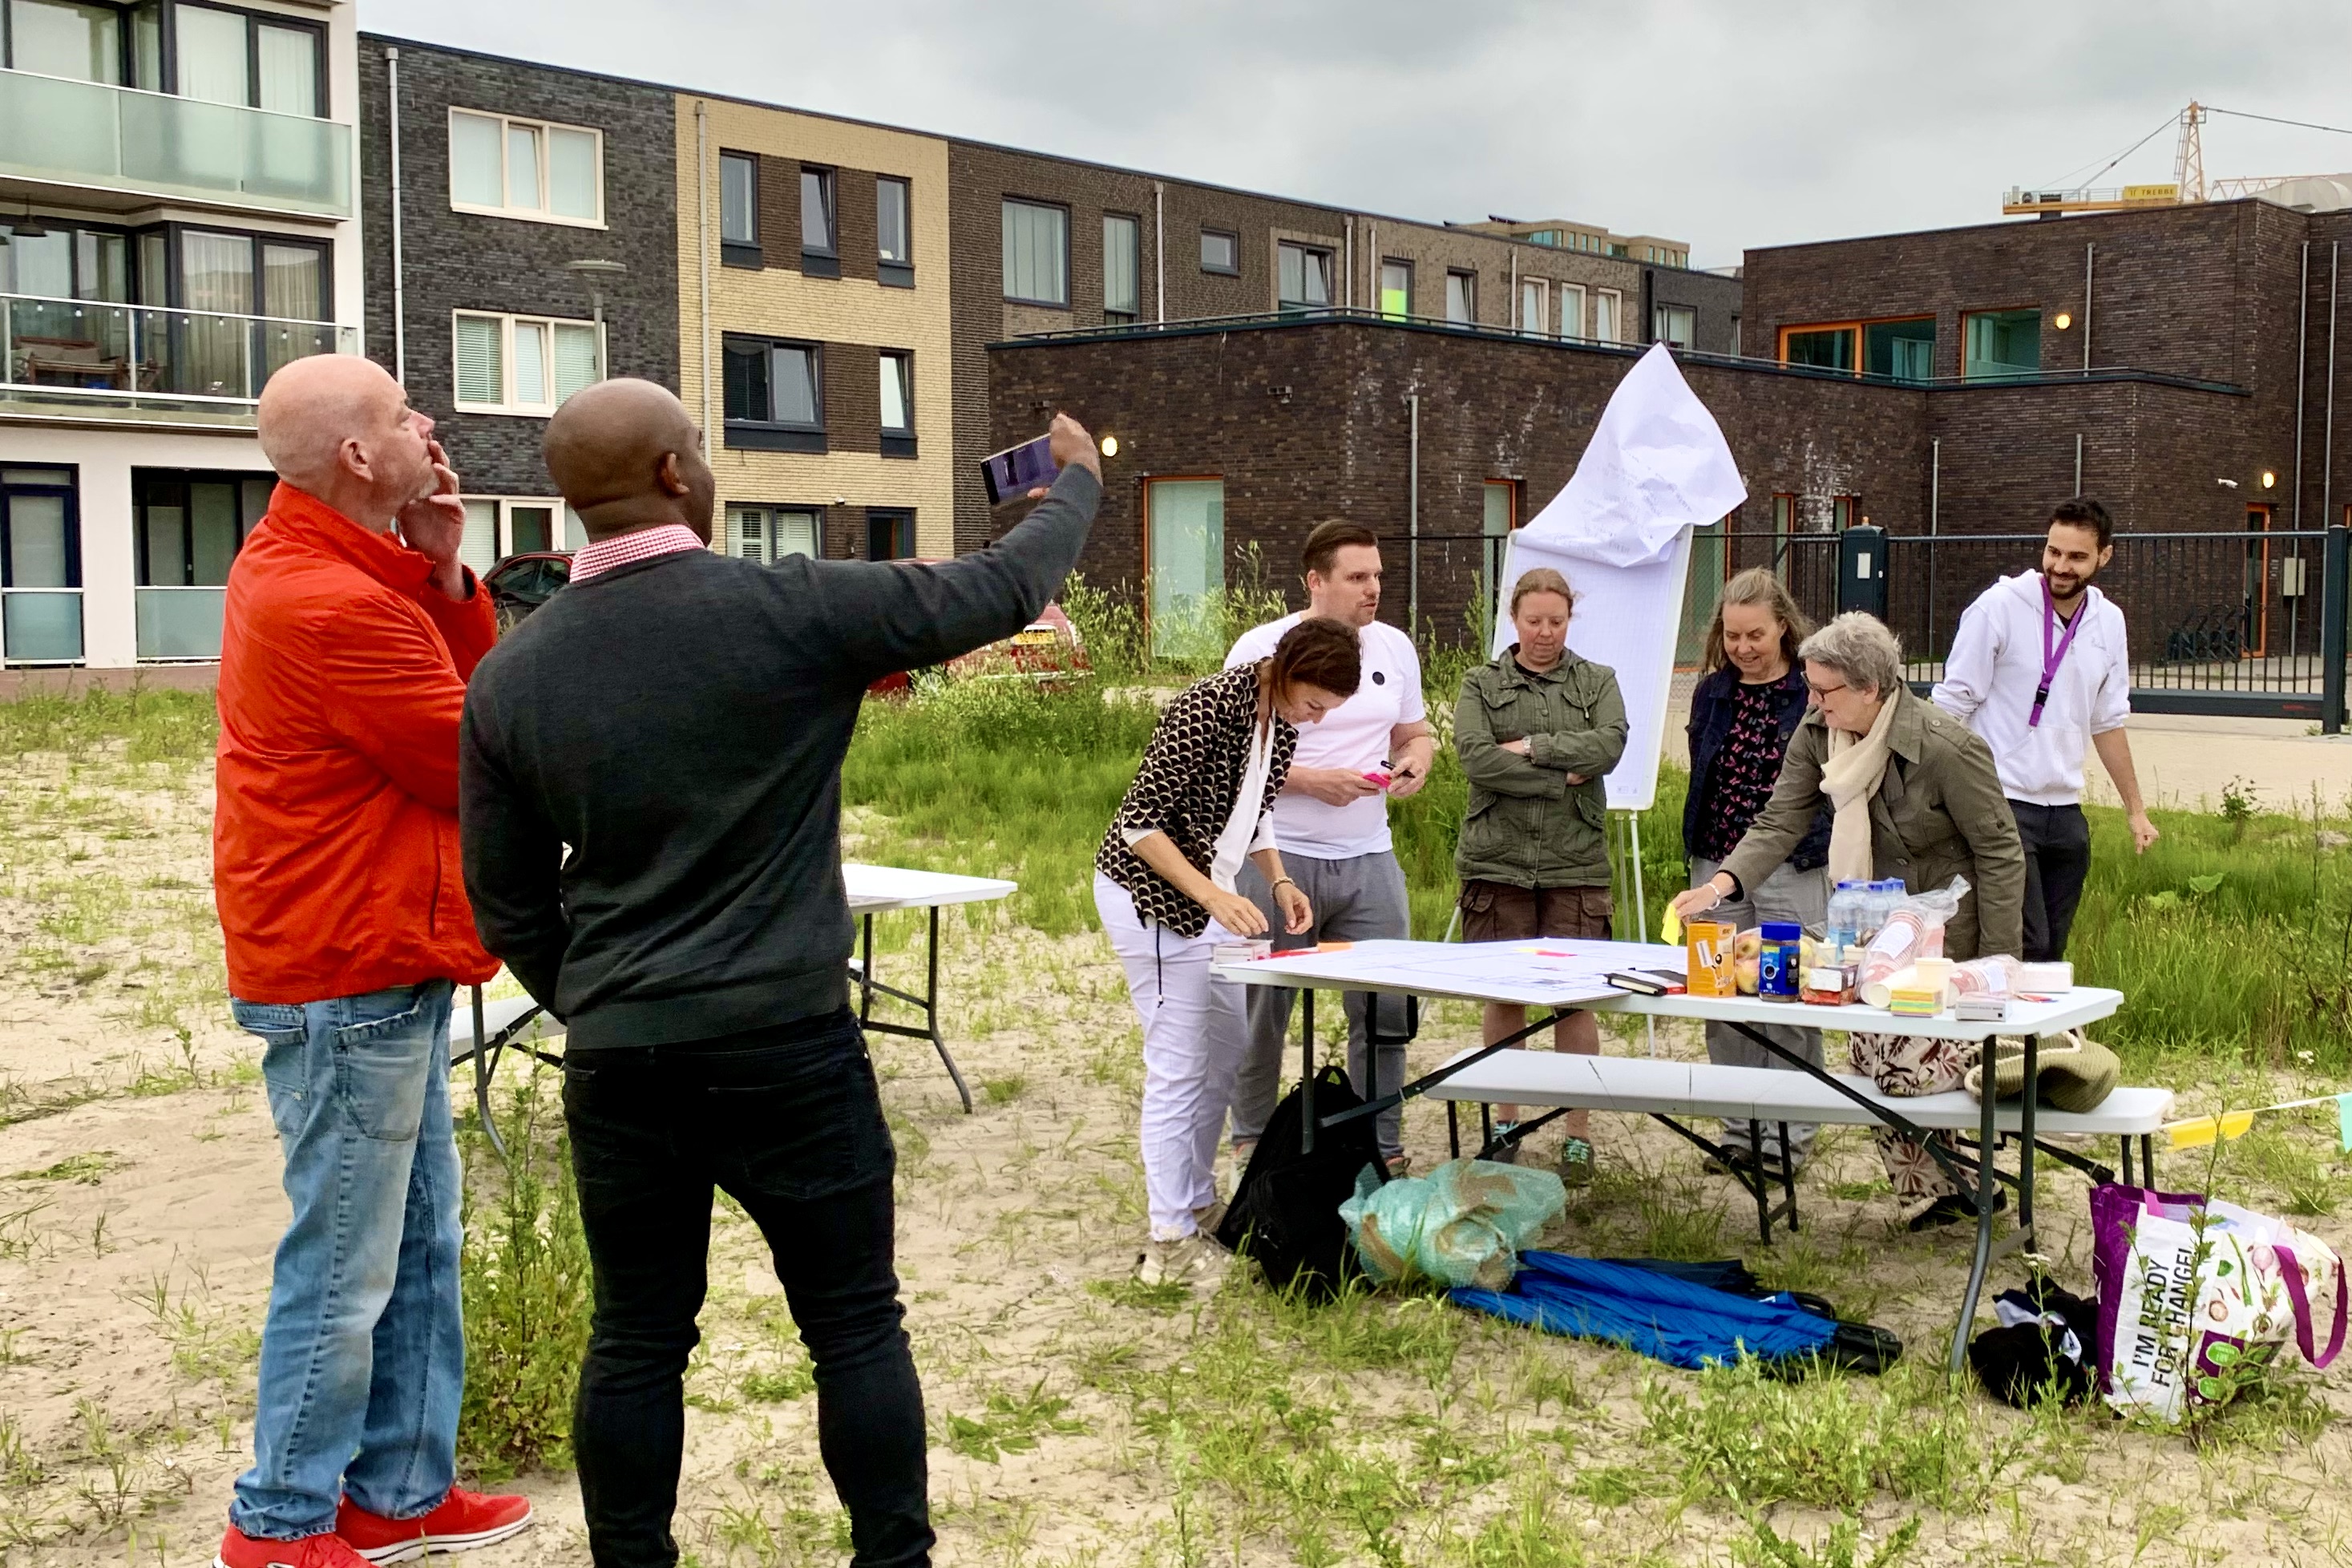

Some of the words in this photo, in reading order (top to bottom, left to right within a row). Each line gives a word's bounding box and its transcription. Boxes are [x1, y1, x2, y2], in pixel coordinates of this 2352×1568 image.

[2139, 1258, 2169, 1329] READY
[2132, 1333, 2156, 1368] I'M
[2151, 1344, 2179, 1388] FOR
